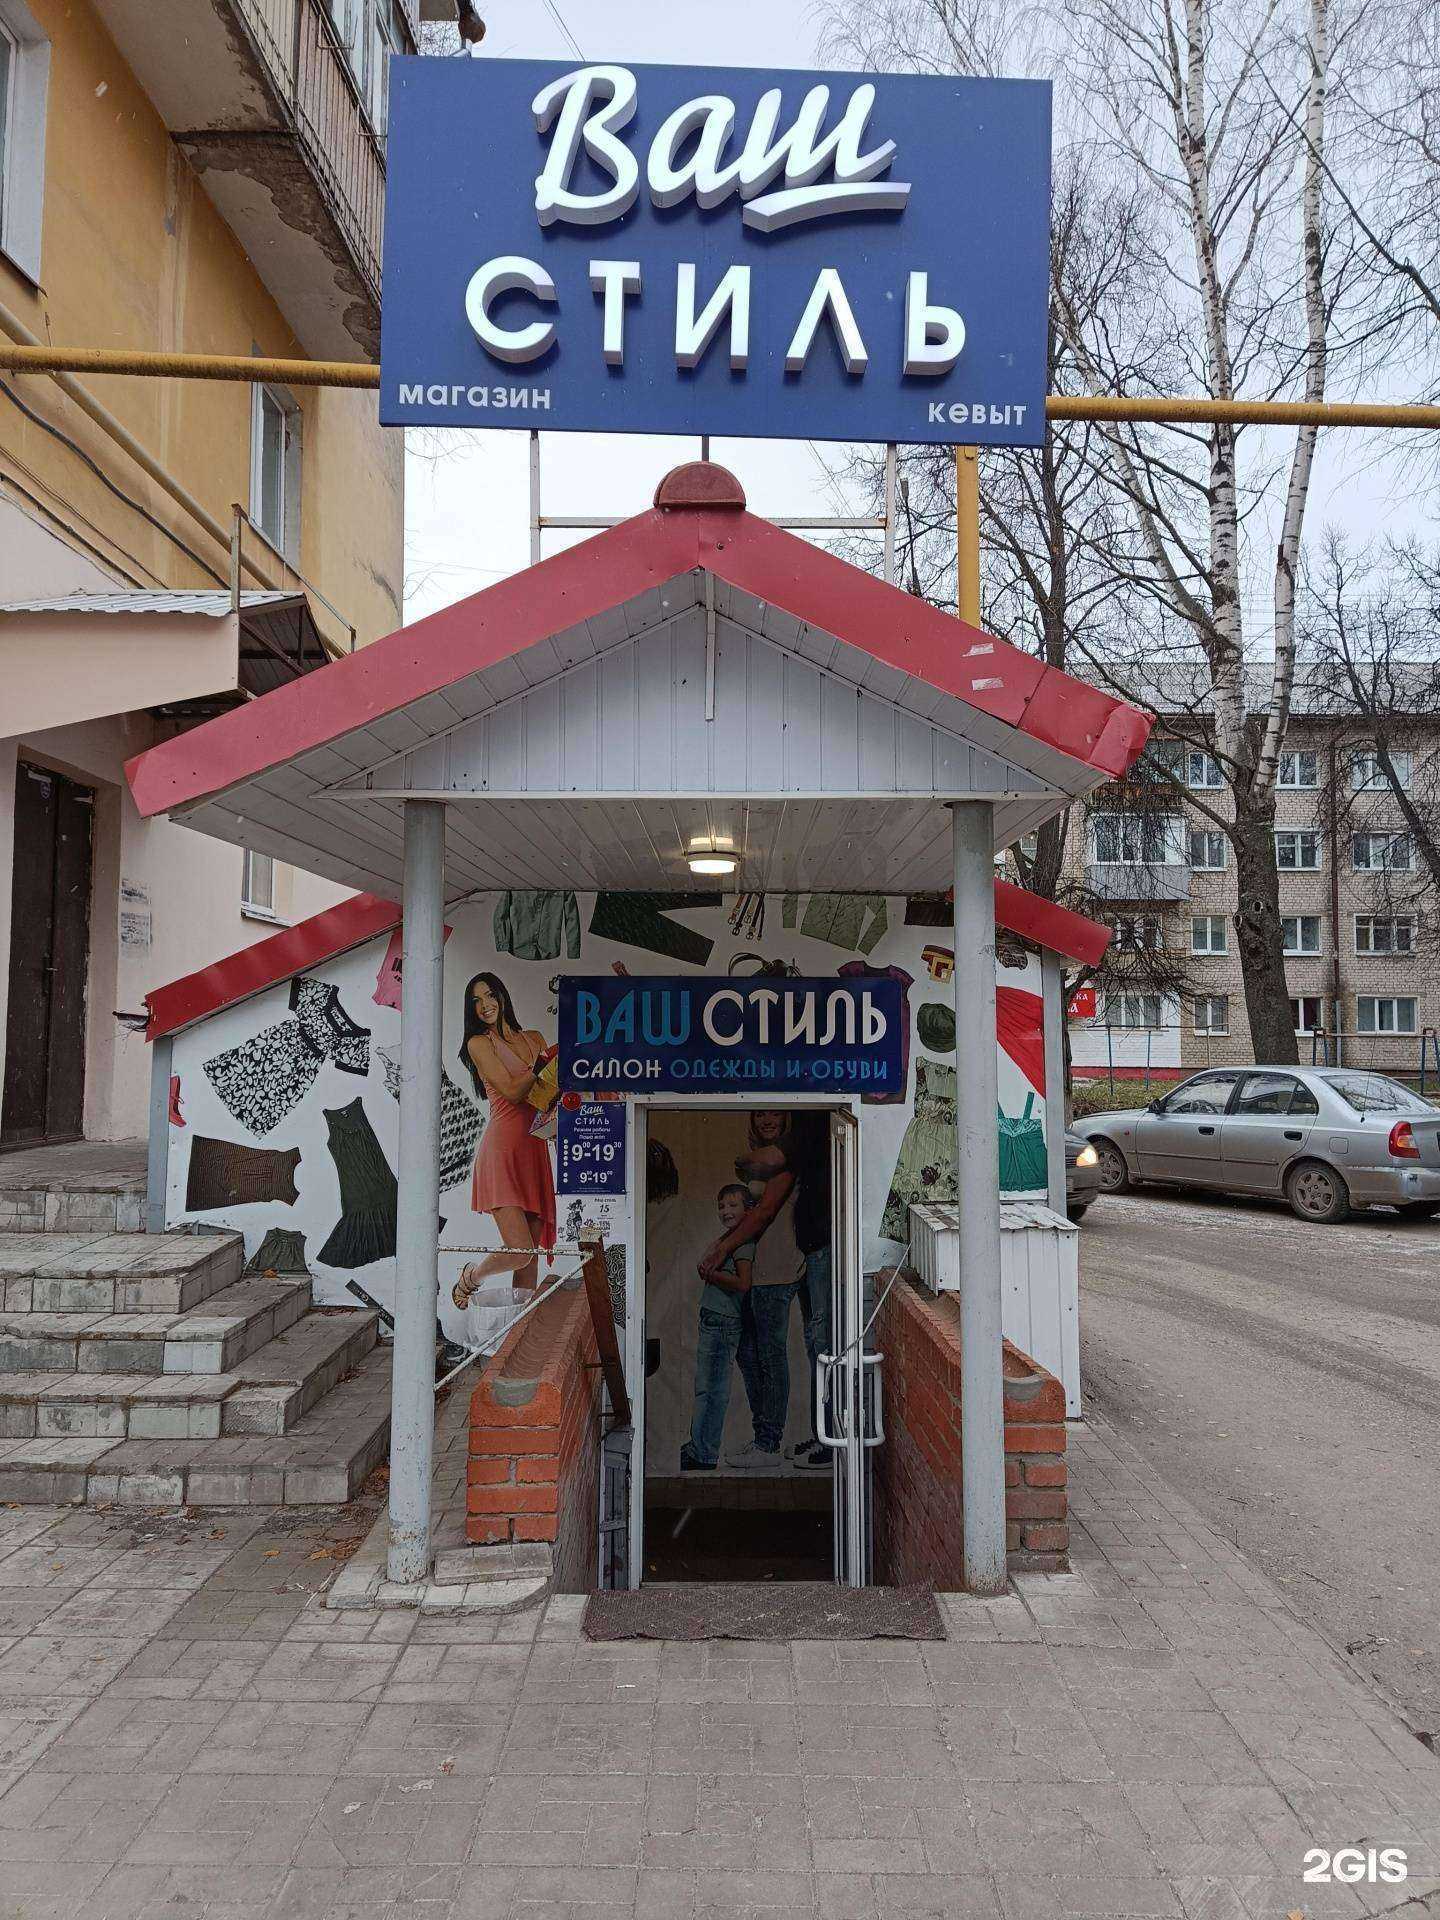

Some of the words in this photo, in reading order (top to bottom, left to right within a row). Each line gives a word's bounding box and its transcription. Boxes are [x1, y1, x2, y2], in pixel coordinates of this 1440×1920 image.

[531, 65, 911, 232] Ваш
[465, 256, 967, 377] СТИЛЬ
[399, 384, 550, 410] магазин
[928, 402, 1027, 426] кевыт
[576, 990, 690, 1046] ВАШ
[702, 989, 888, 1046] СТИЛЬ
[572, 1058, 662, 1079] САЛОН
[670, 1059, 775, 1079] ОДЕЖДЫ
[786, 1059, 800, 1079] И
[811, 1059, 887, 1079] ОБУВИ
[575, 1117, 610, 1125] СТИЛЬ
[580, 1104, 605, 1116] Ваш
